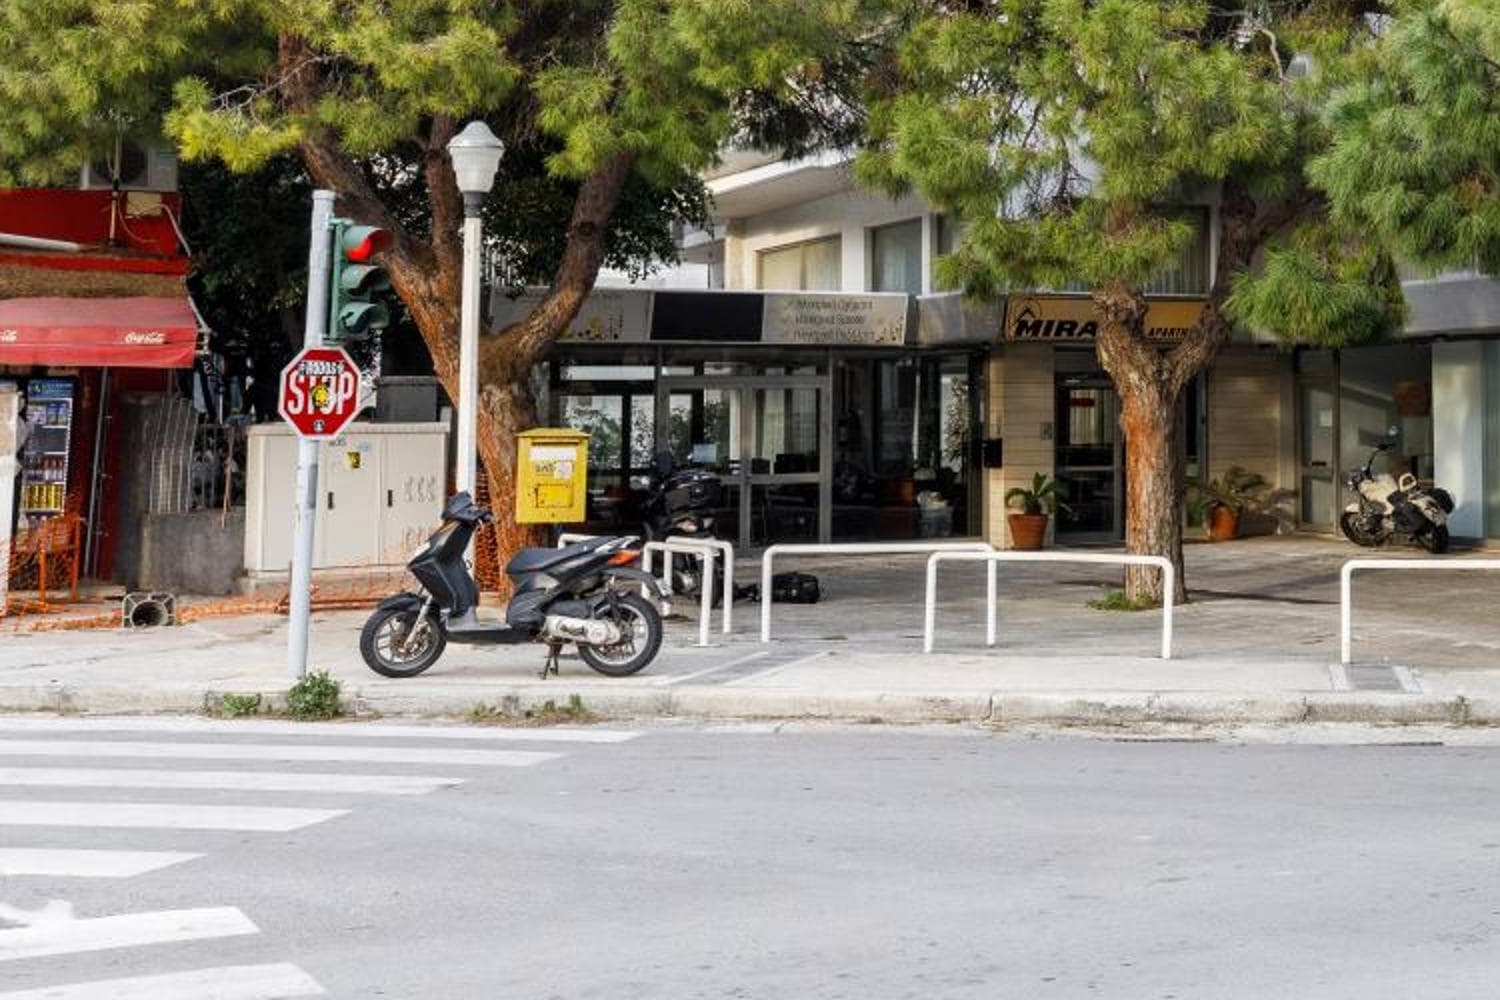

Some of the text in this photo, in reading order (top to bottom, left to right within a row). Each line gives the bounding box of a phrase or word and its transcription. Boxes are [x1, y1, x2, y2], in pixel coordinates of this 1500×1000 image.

[1015, 319, 1189, 337] MIRA APARTM
[287, 370, 355, 415] STOP
